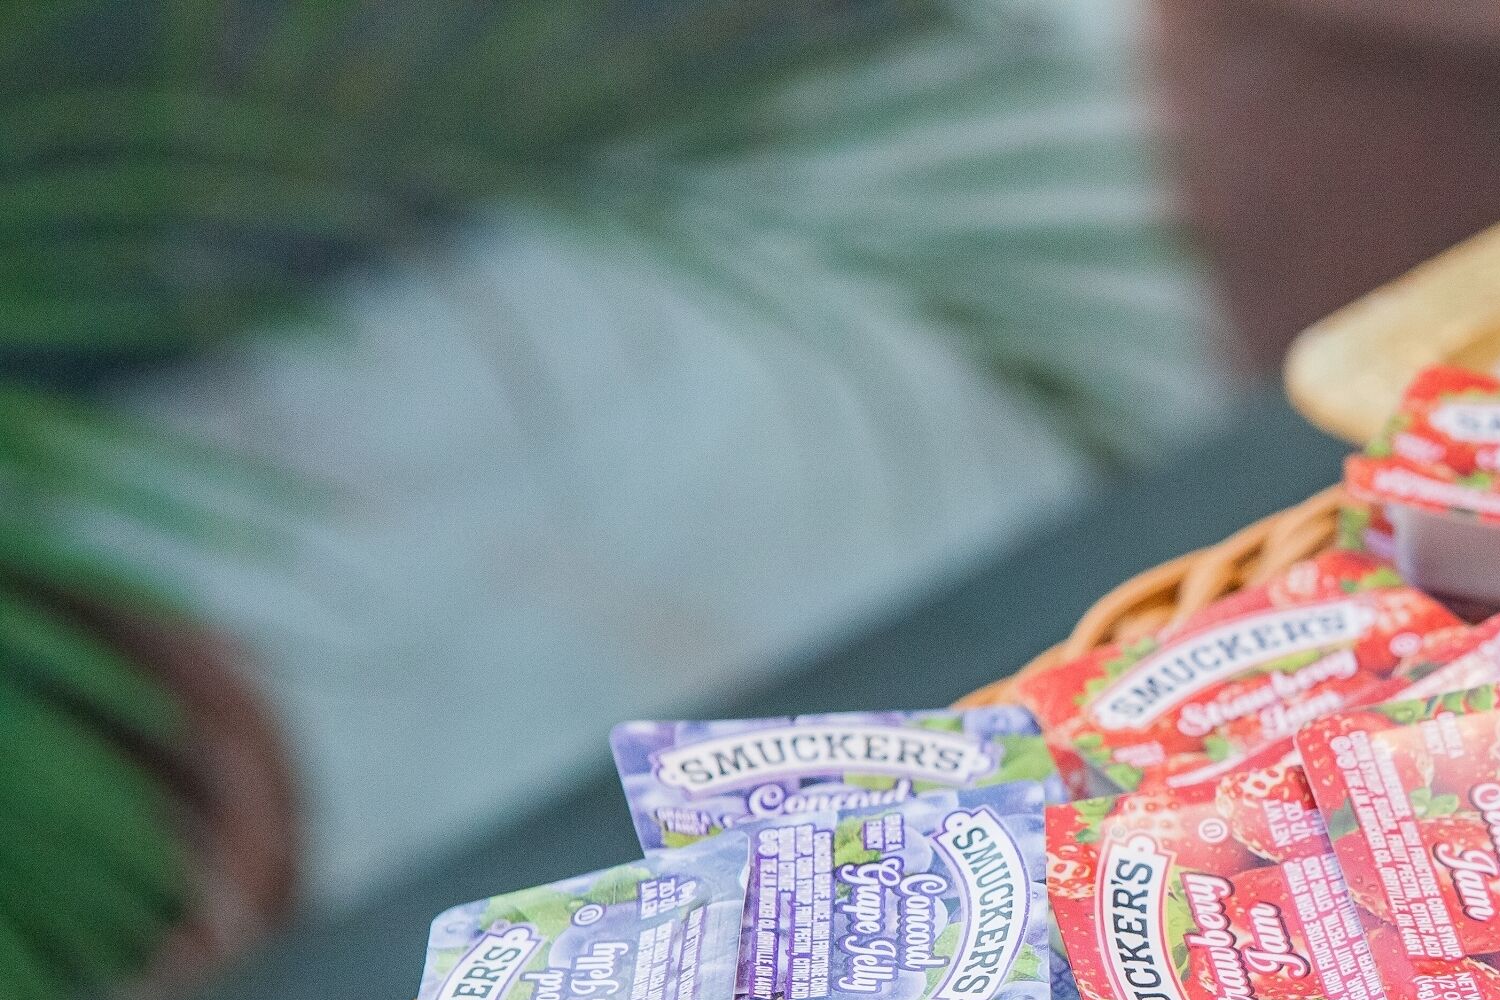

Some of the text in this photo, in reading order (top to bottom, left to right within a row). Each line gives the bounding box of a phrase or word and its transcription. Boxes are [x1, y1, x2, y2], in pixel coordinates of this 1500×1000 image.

[1110, 609, 1349, 716] SMUCKER'S
[681, 733, 965, 785] SMUCKER'S
[749, 780, 914, 817] Concord
[842, 859, 899, 934] Grape
[1435, 843, 1499, 921] Jam
[901, 874, 948, 967] Concord
[952, 826, 1014, 996] SMUCKER'S
[839, 937, 896, 993] Jelly
[1245, 902, 1309, 977] Jam
[1303, 919, 1335, 970] FRUCTOSE
[1333, 945, 1358, 974] FRUIT
[1421, 932, 1443, 958] ACID
[571, 942, 629, 995] Jelly
[1320, 969, 1345, 994] HIGH
[1436, 975, 1457, 990] 1/2
[1455, 972, 1478, 992] NET
